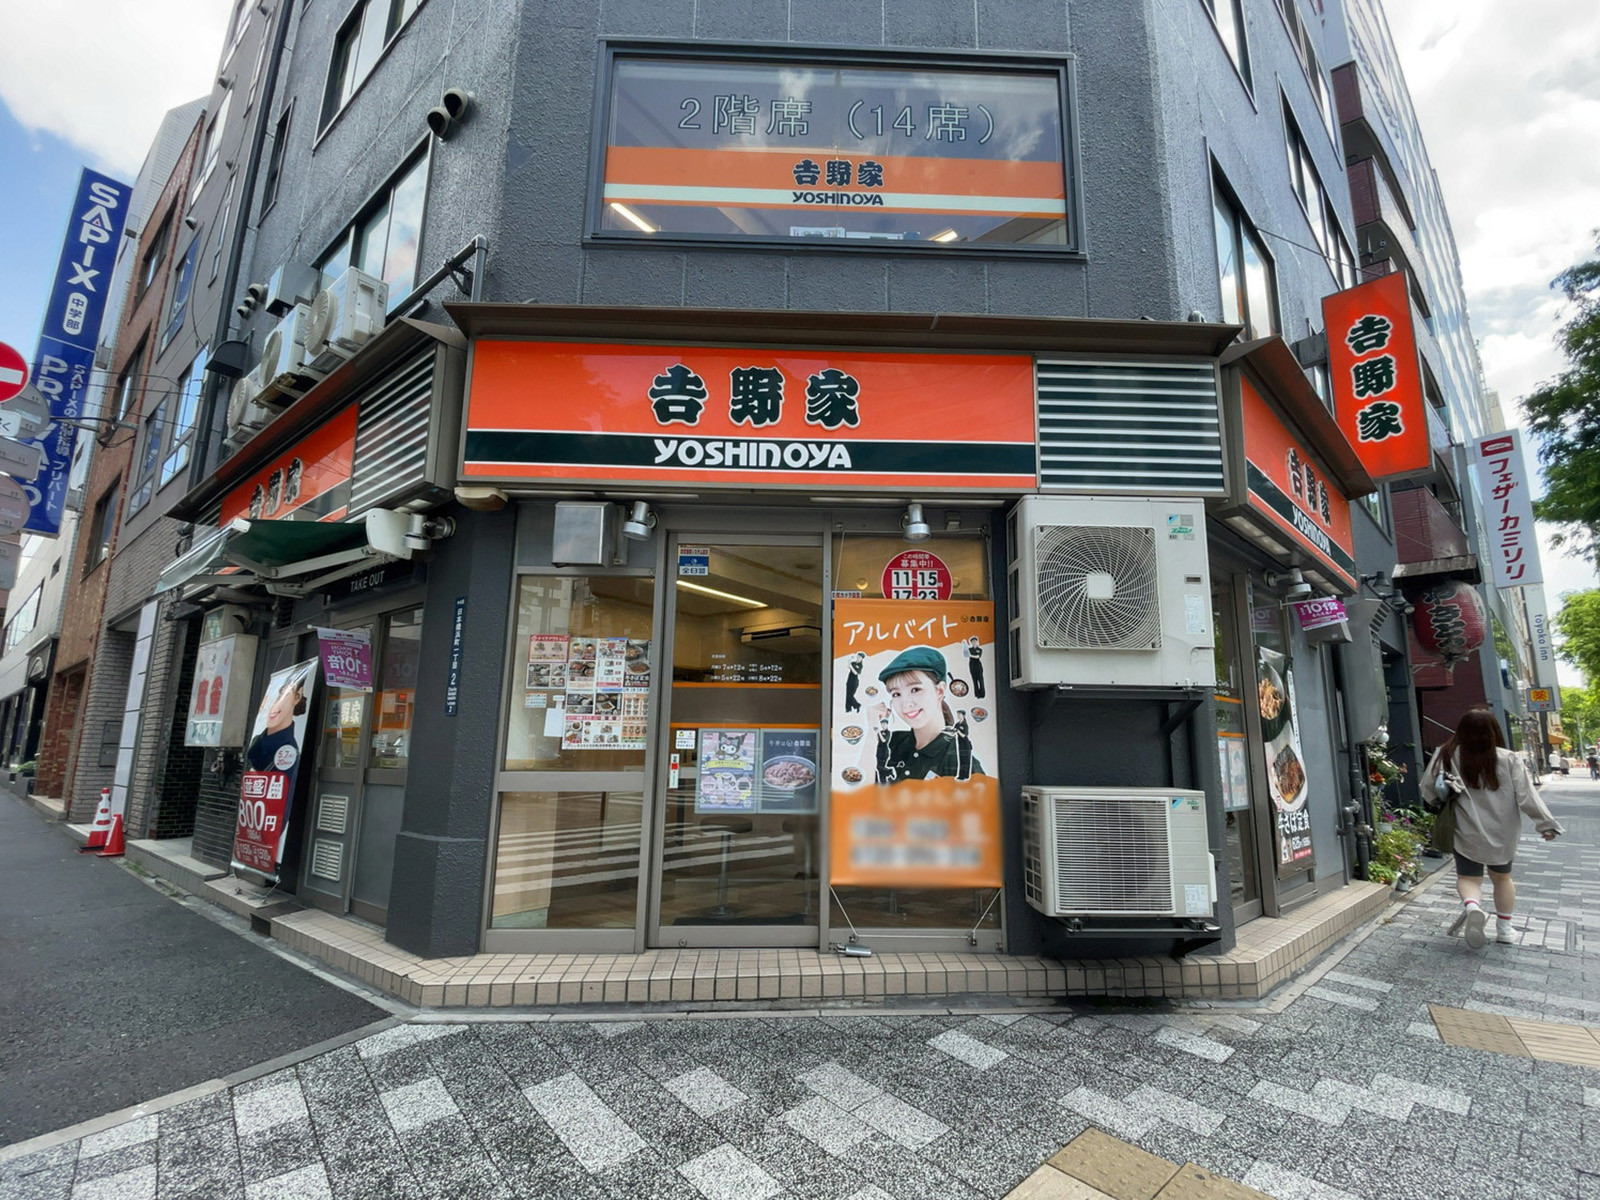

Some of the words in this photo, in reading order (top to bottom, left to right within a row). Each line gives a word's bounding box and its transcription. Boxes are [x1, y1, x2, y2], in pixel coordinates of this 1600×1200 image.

[678, 95, 812, 137] 2階席
[848, 100, 995, 145] (14席)
[792, 190, 884, 206] YOSHINOYA
[67, 182, 120, 292] SAPIX
[65, 297, 85, 331] 中学部
[654, 439, 852, 468] YOSHINOYA
[1292, 505, 1331, 556] YOSHINOYA
[1489, 457, 1526, 581] フェザーカミソリ
[351, 576, 368, 592] TAKE
[369, 570, 385, 587] OUT
[843, 614, 959, 646] アルバイト
[1534, 614, 1546, 645] toyoko
[1540, 647, 1549, 661] inn
[450, 673, 457, 685] 2
[239, 799, 277, 831] 800円
